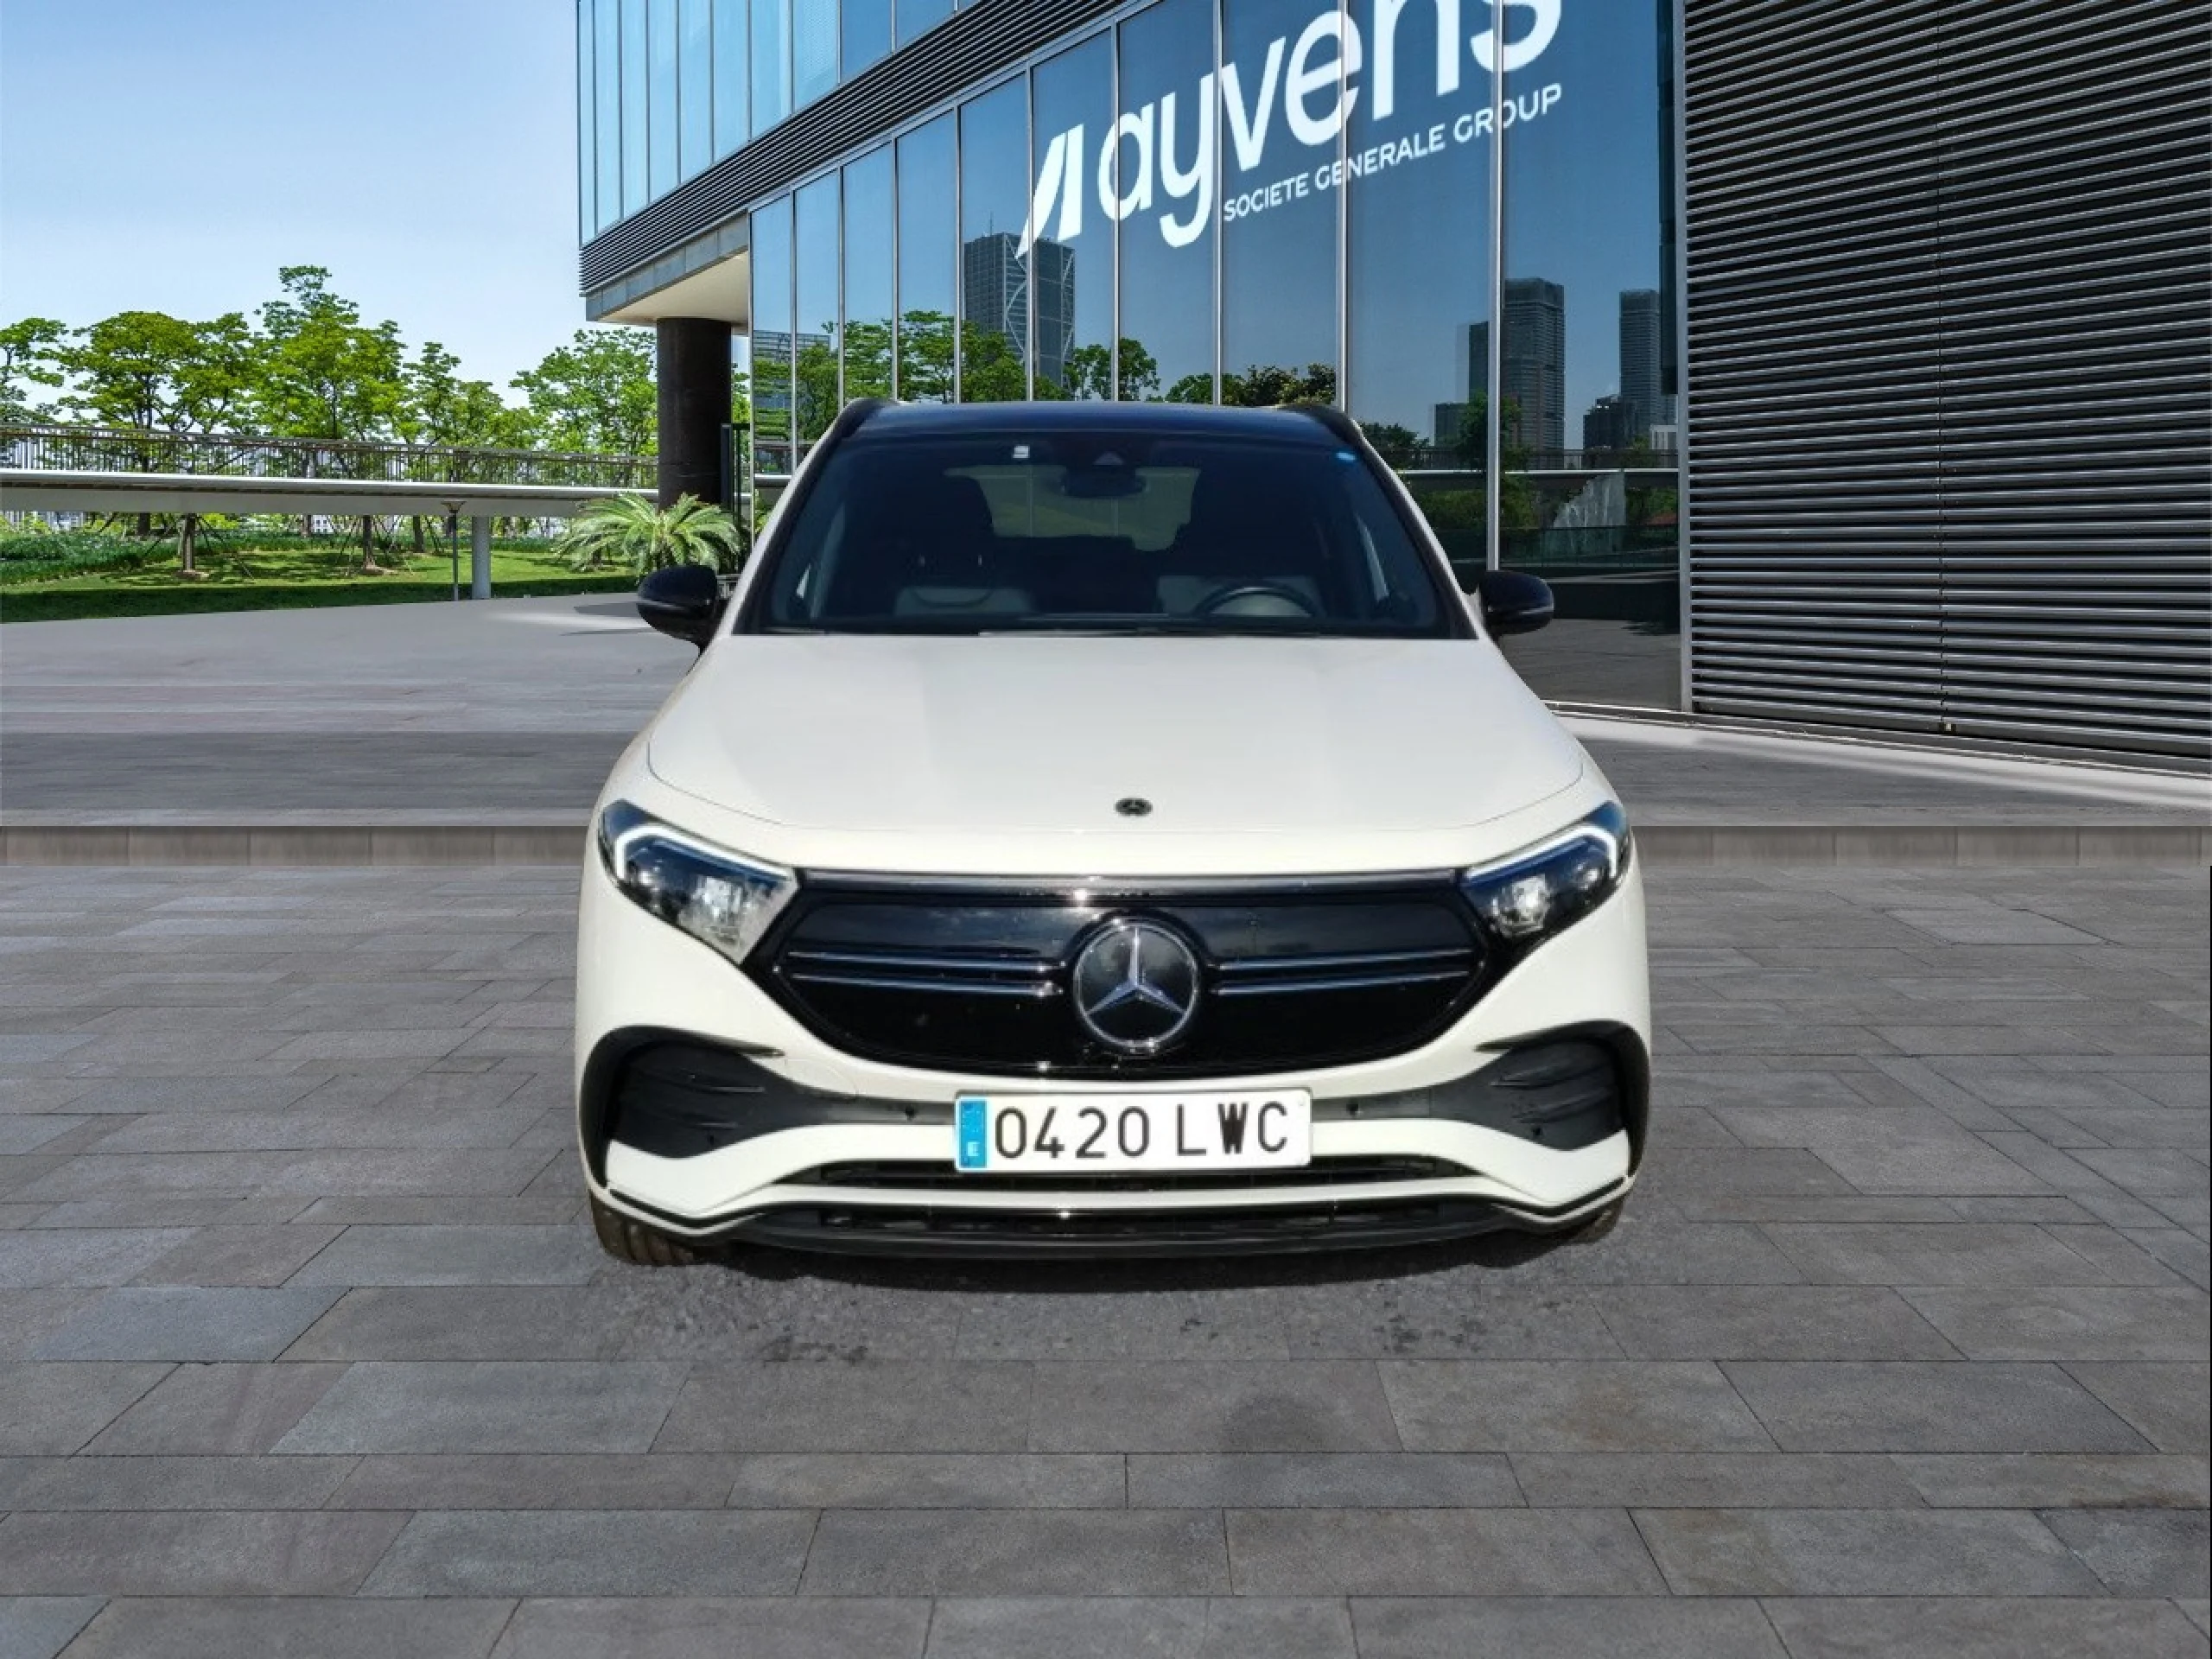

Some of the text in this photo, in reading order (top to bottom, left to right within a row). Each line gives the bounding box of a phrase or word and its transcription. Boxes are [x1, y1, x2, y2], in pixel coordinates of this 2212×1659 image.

[1223, 82, 1562, 222] SOCIETE GENERALE GROUP
[995, 1101, 1288, 1160] 0420 LWC
